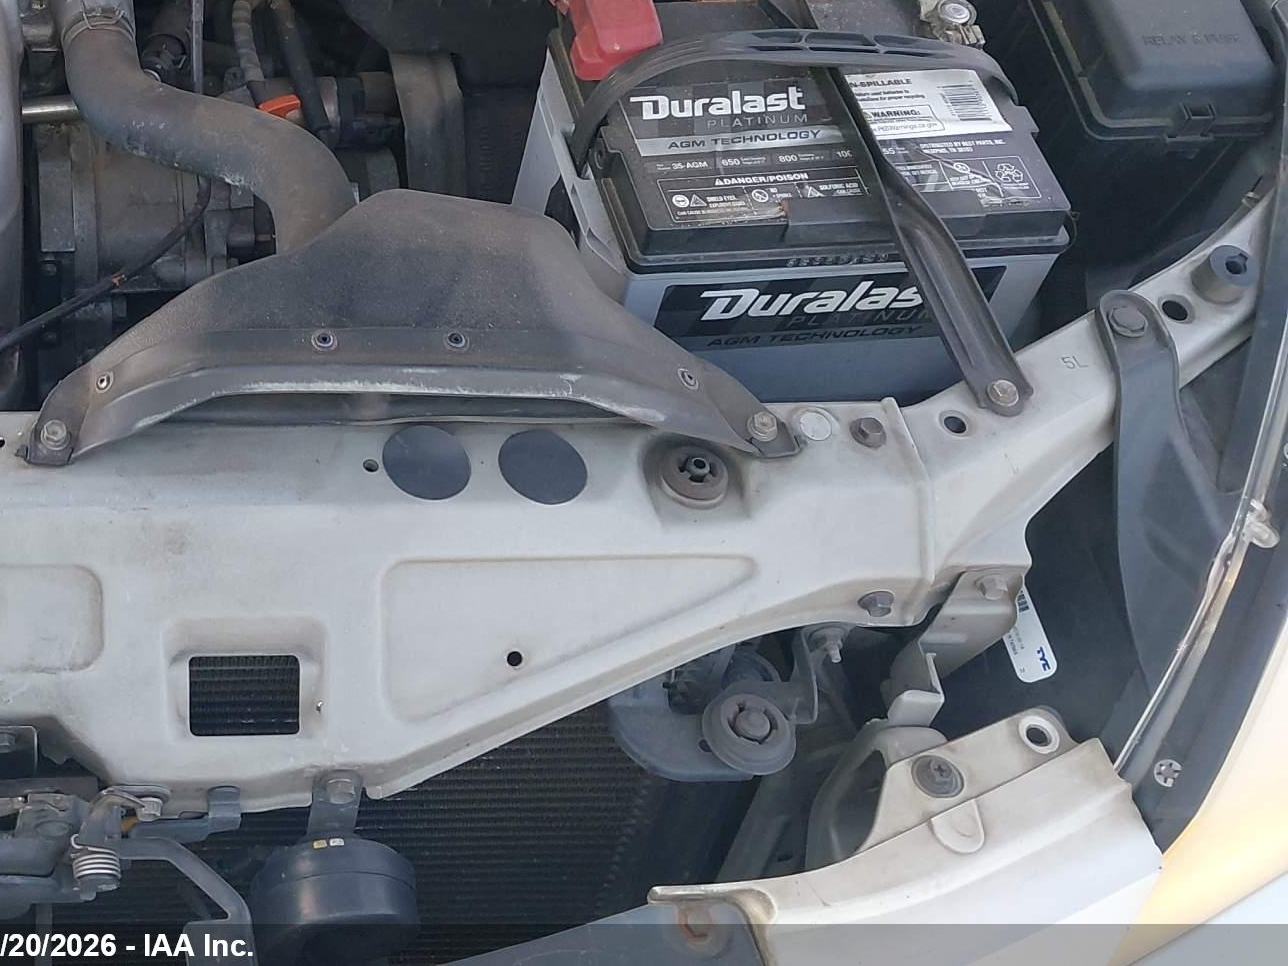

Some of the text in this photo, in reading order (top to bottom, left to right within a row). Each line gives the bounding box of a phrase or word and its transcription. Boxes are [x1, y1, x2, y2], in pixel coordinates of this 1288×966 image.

[850, 78, 913, 88] N-SPILLABLE
[629, 86, 806, 120] Duralast
[706, 113, 808, 130] PLATINUM
[871, 109, 921, 118] WARNING:
[667, 129, 822, 149] AGM TECHNOLOGY
[671, 161, 709, 170] 35-AGM
[721, 158, 740, 167] 650
[778, 154, 798, 163] 800
[723, 172, 809, 186] DANGER/POISON
[700, 280, 924, 321] Duralas
[707, 324, 923, 347] AGM TECHNOLOGY
[1036, 646, 1051, 671] TYC
